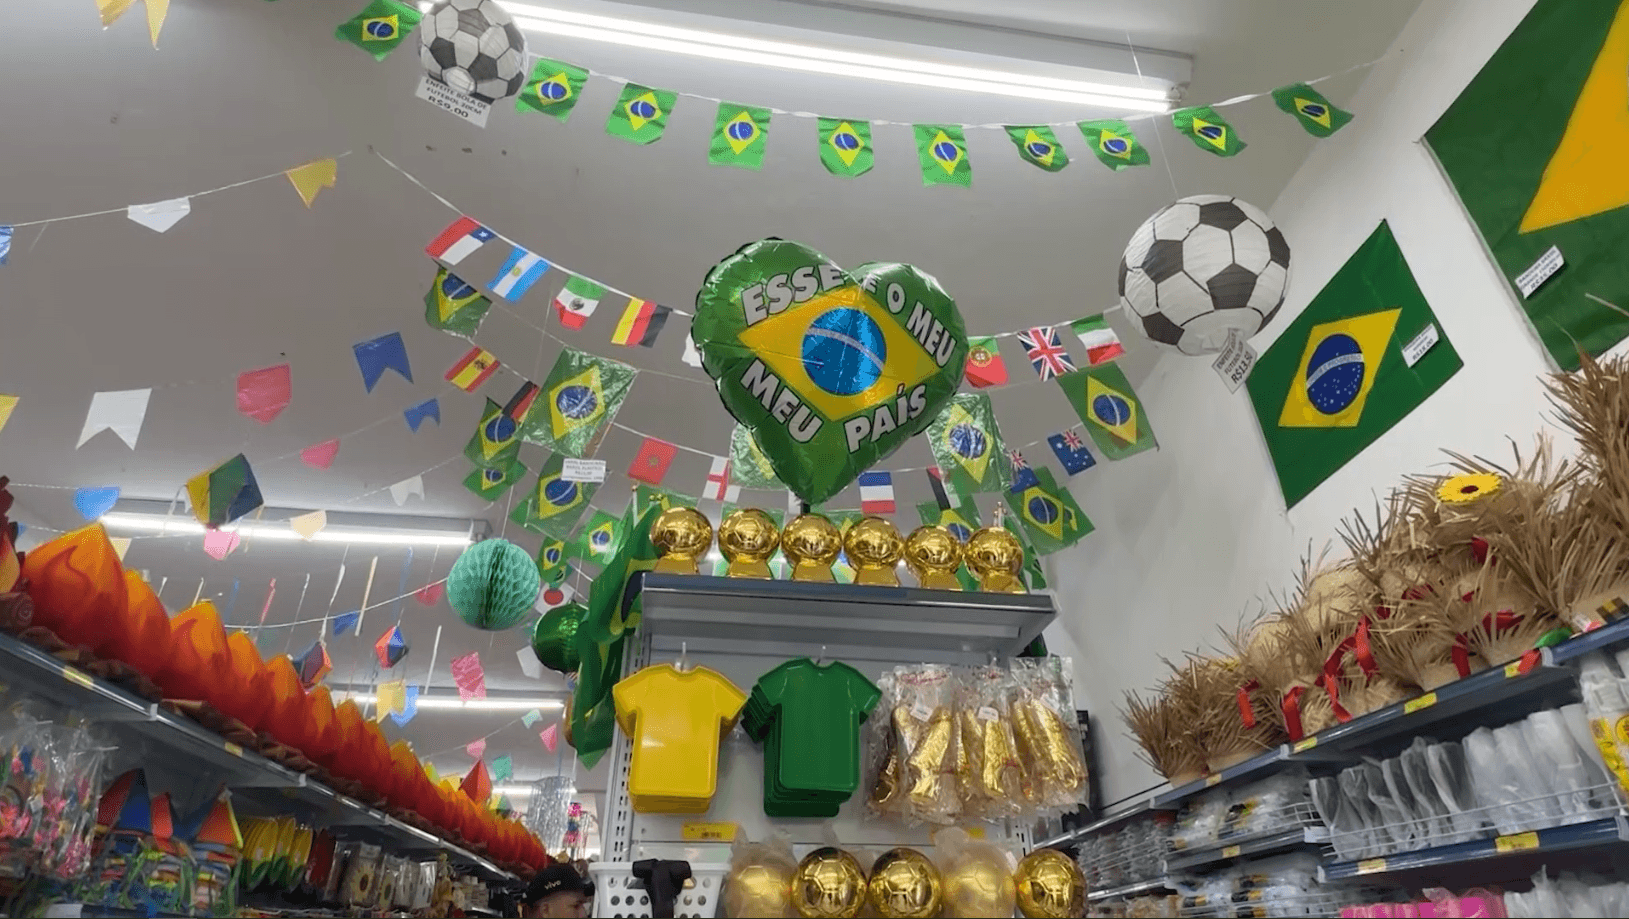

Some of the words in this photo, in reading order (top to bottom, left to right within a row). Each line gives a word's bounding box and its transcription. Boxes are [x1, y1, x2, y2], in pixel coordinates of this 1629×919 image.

[477, 101, 487, 109] DE
[740, 264, 845, 328] ESSE
[886, 282, 906, 315] O
[905, 301, 957, 368] MEU
[740, 357, 824, 443] MEU
[843, 382, 927, 454] PAÍS
[544, 880, 561, 890] vivo
